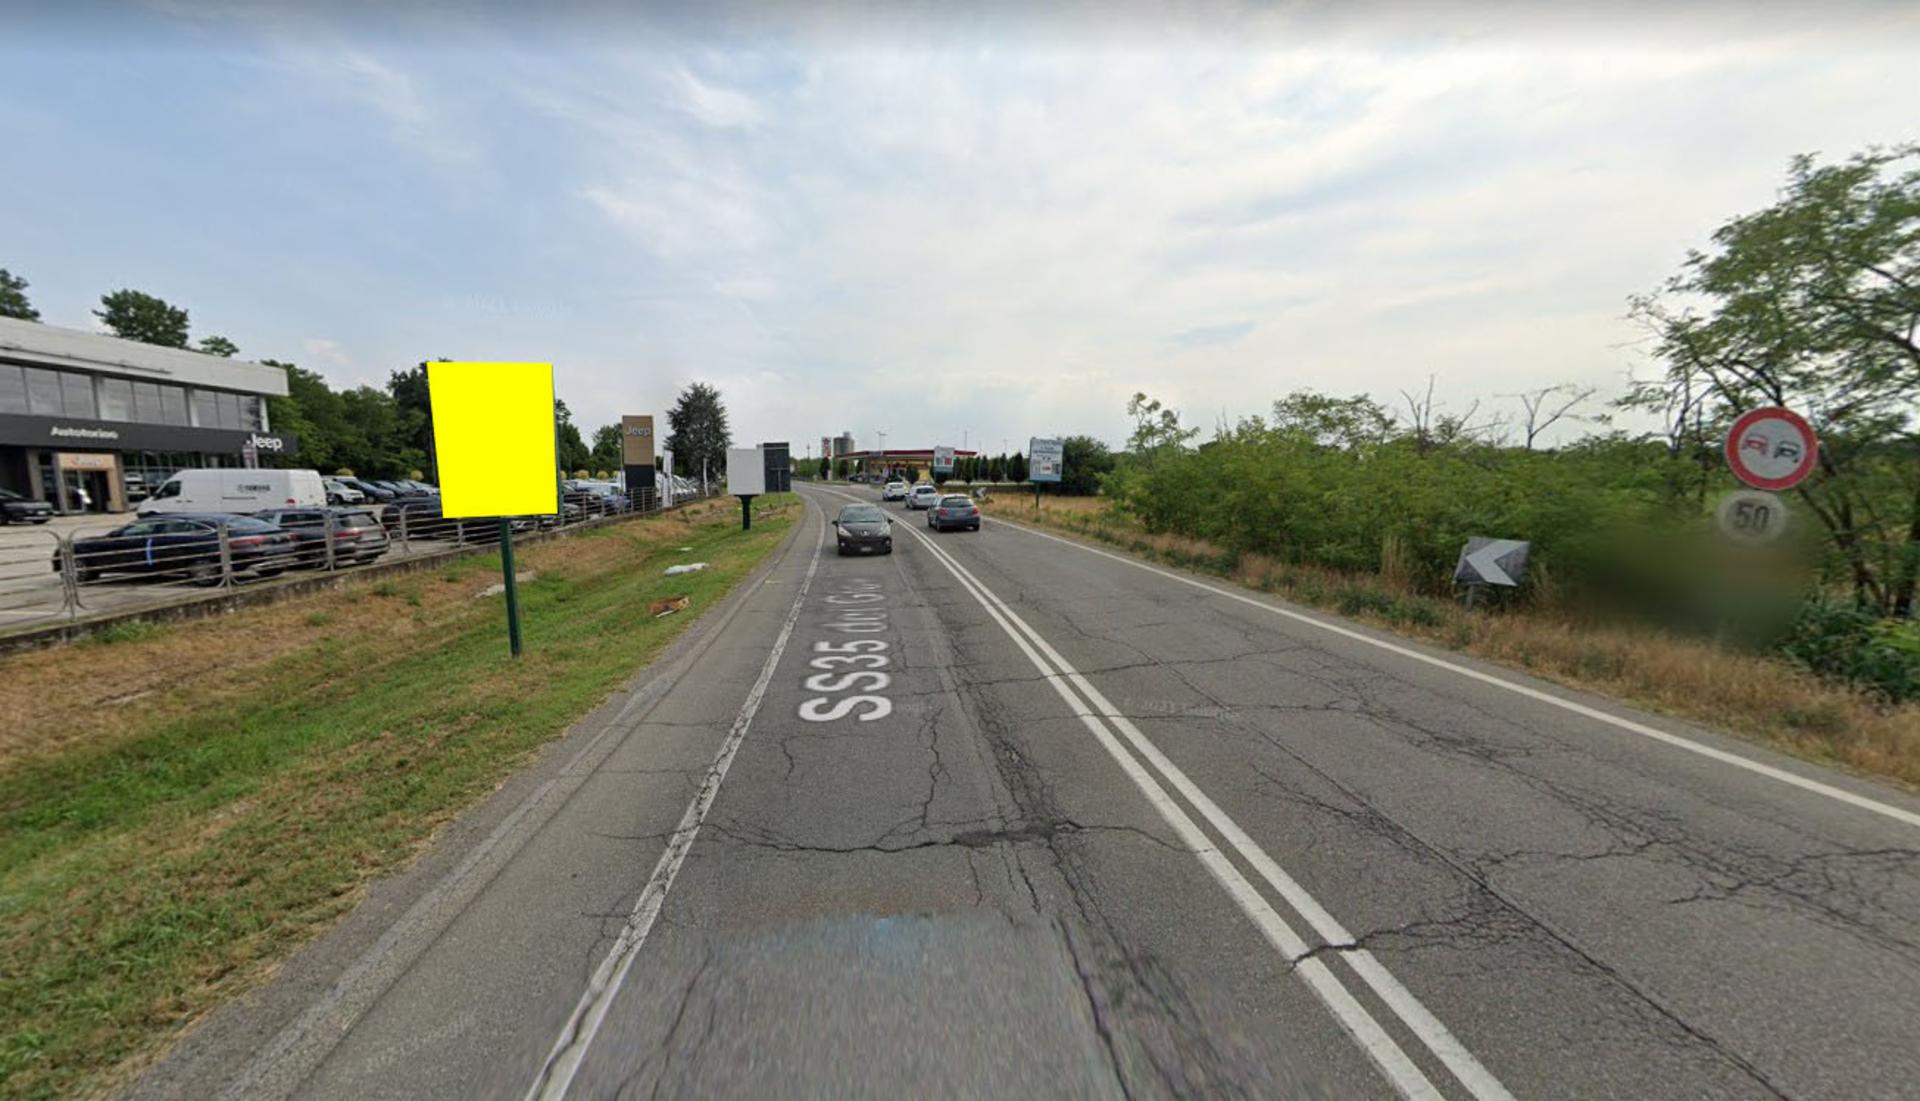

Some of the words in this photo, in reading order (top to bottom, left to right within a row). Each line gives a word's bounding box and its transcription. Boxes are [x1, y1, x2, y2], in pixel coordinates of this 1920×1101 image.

[625, 426, 651, 437] Jeep
[246, 433, 283, 452] Jeep
[1733, 500, 1770, 533] 50
